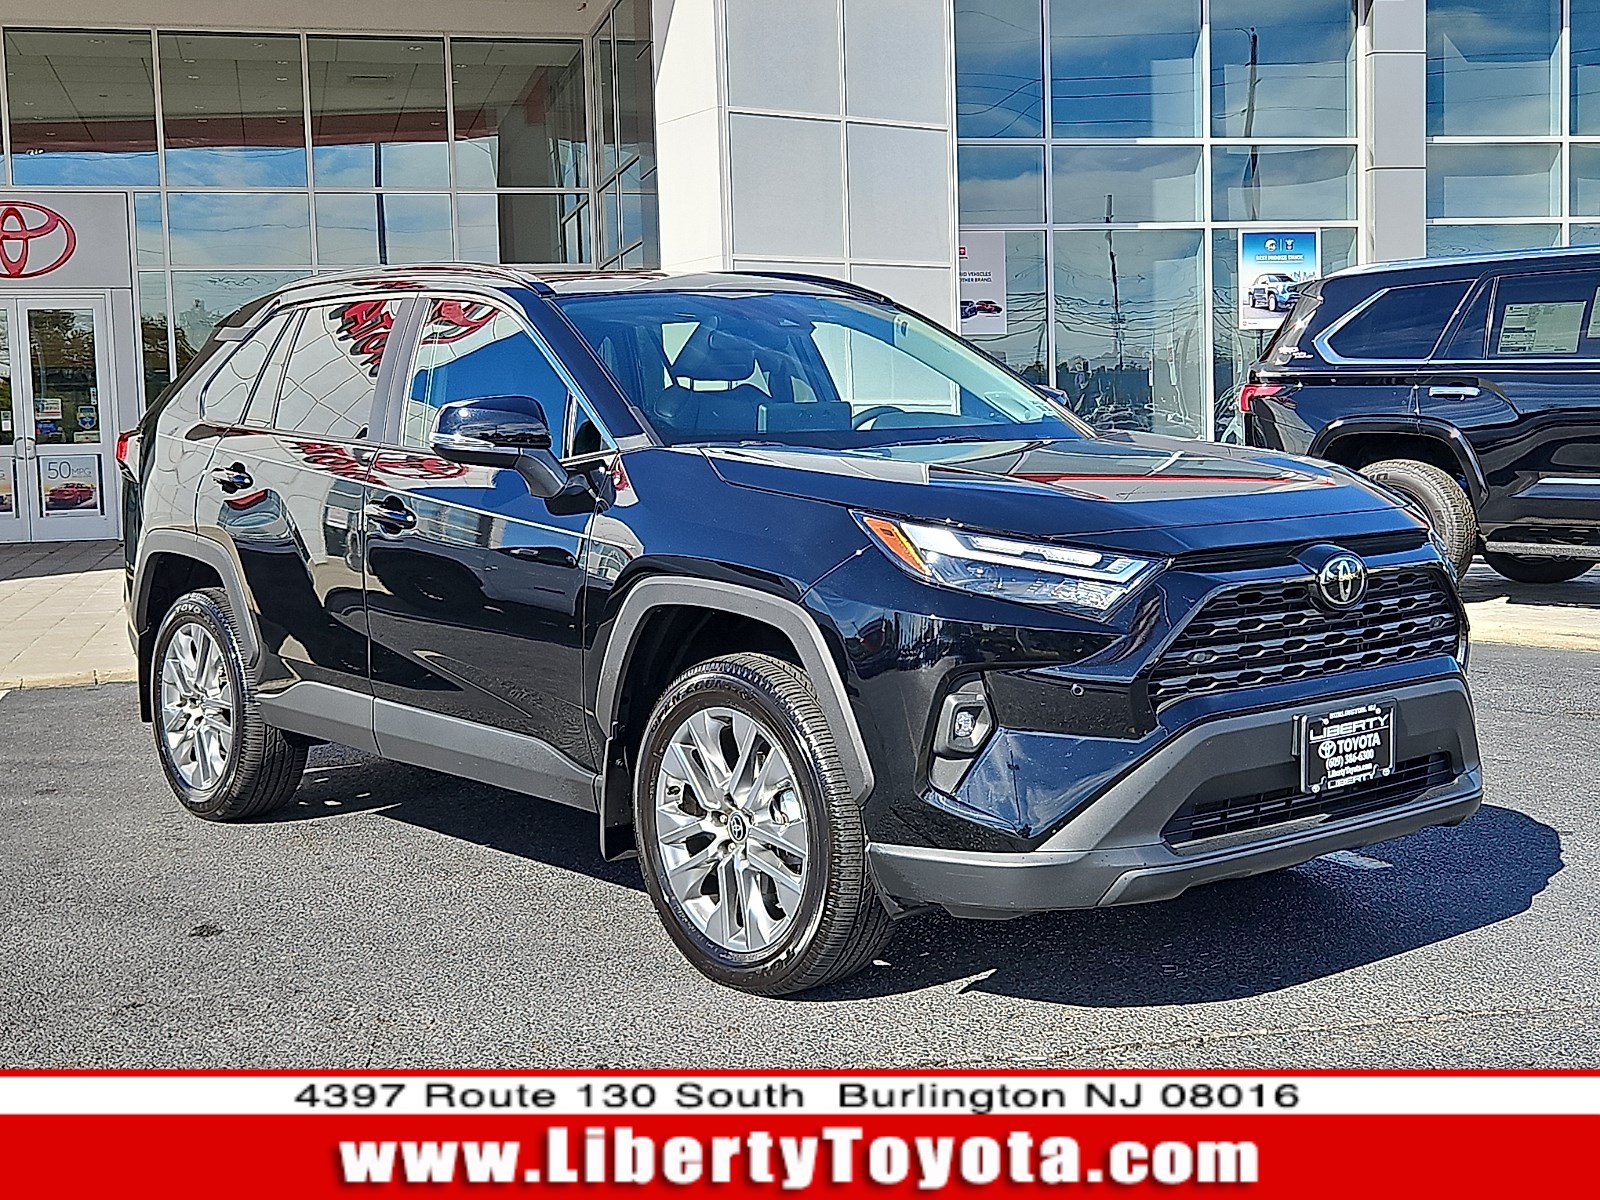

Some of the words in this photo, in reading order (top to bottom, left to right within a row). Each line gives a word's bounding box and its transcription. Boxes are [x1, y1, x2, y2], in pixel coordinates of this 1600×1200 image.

[47, 461, 71, 479] 50
[72, 467, 92, 476] MPG
[175, 604, 201, 614] TOYO
[1309, 714, 1389, 740] LIBERTY
[1337, 732, 1381, 754] TOYOTA
